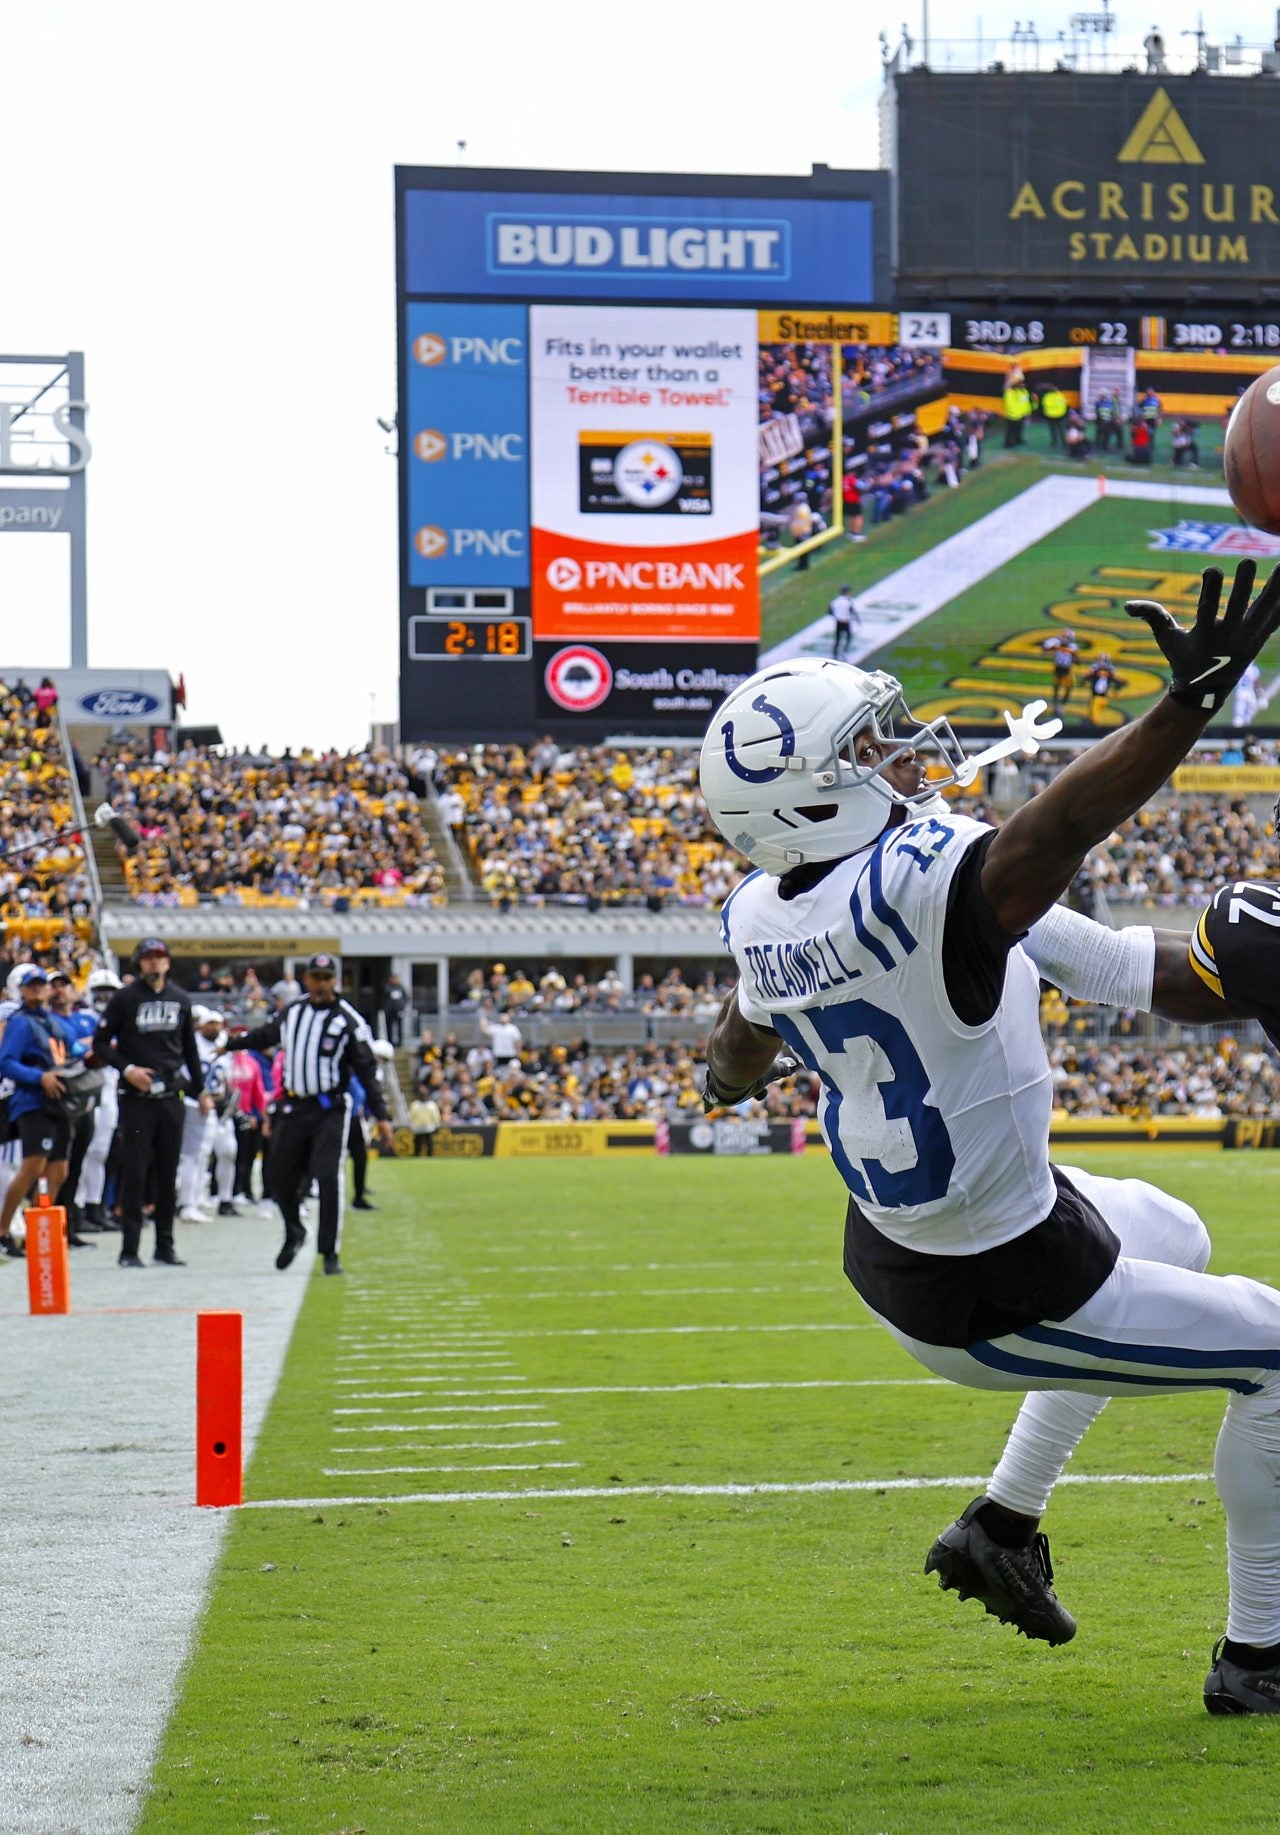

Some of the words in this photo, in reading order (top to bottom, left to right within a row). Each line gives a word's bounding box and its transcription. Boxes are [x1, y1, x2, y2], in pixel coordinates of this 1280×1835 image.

[499, 224, 614, 266] BUD
[620, 228, 781, 269] LIGHT
[1069, 232, 1250, 264] STADIUM
[779, 314, 870, 341] Steelers
[909, 320, 939, 338] 24
[1069, 327, 1097, 344] ON
[1100, 323, 1128, 345] 22
[1173, 324, 1222, 345] 3RD
[1230, 324, 1280, 347] 2:18
[451, 336, 523, 366] PNC
[545, 337, 585, 356] Fits
[590, 338, 611, 356] in
[617, 342, 666, 361] your
[673, 341, 743, 359] wallet
[569, 363, 640, 381] better
[647, 364, 699, 382] than
[705, 369, 719, 383] a
[566, 386, 652, 405] Terrible
[451, 432, 523, 461] PNC
[452, 528, 524, 557] PNC
[585, 561, 655, 589] PNC
[657, 562, 746, 591] BANK
[444, 621, 520, 655] 2:18
[614, 668, 675, 691] South
[94, 691, 147, 717] Ford
[895, 818, 956, 875] 13
[744, 930, 864, 1001] TREADWELL
[770, 997, 957, 1209] 13
